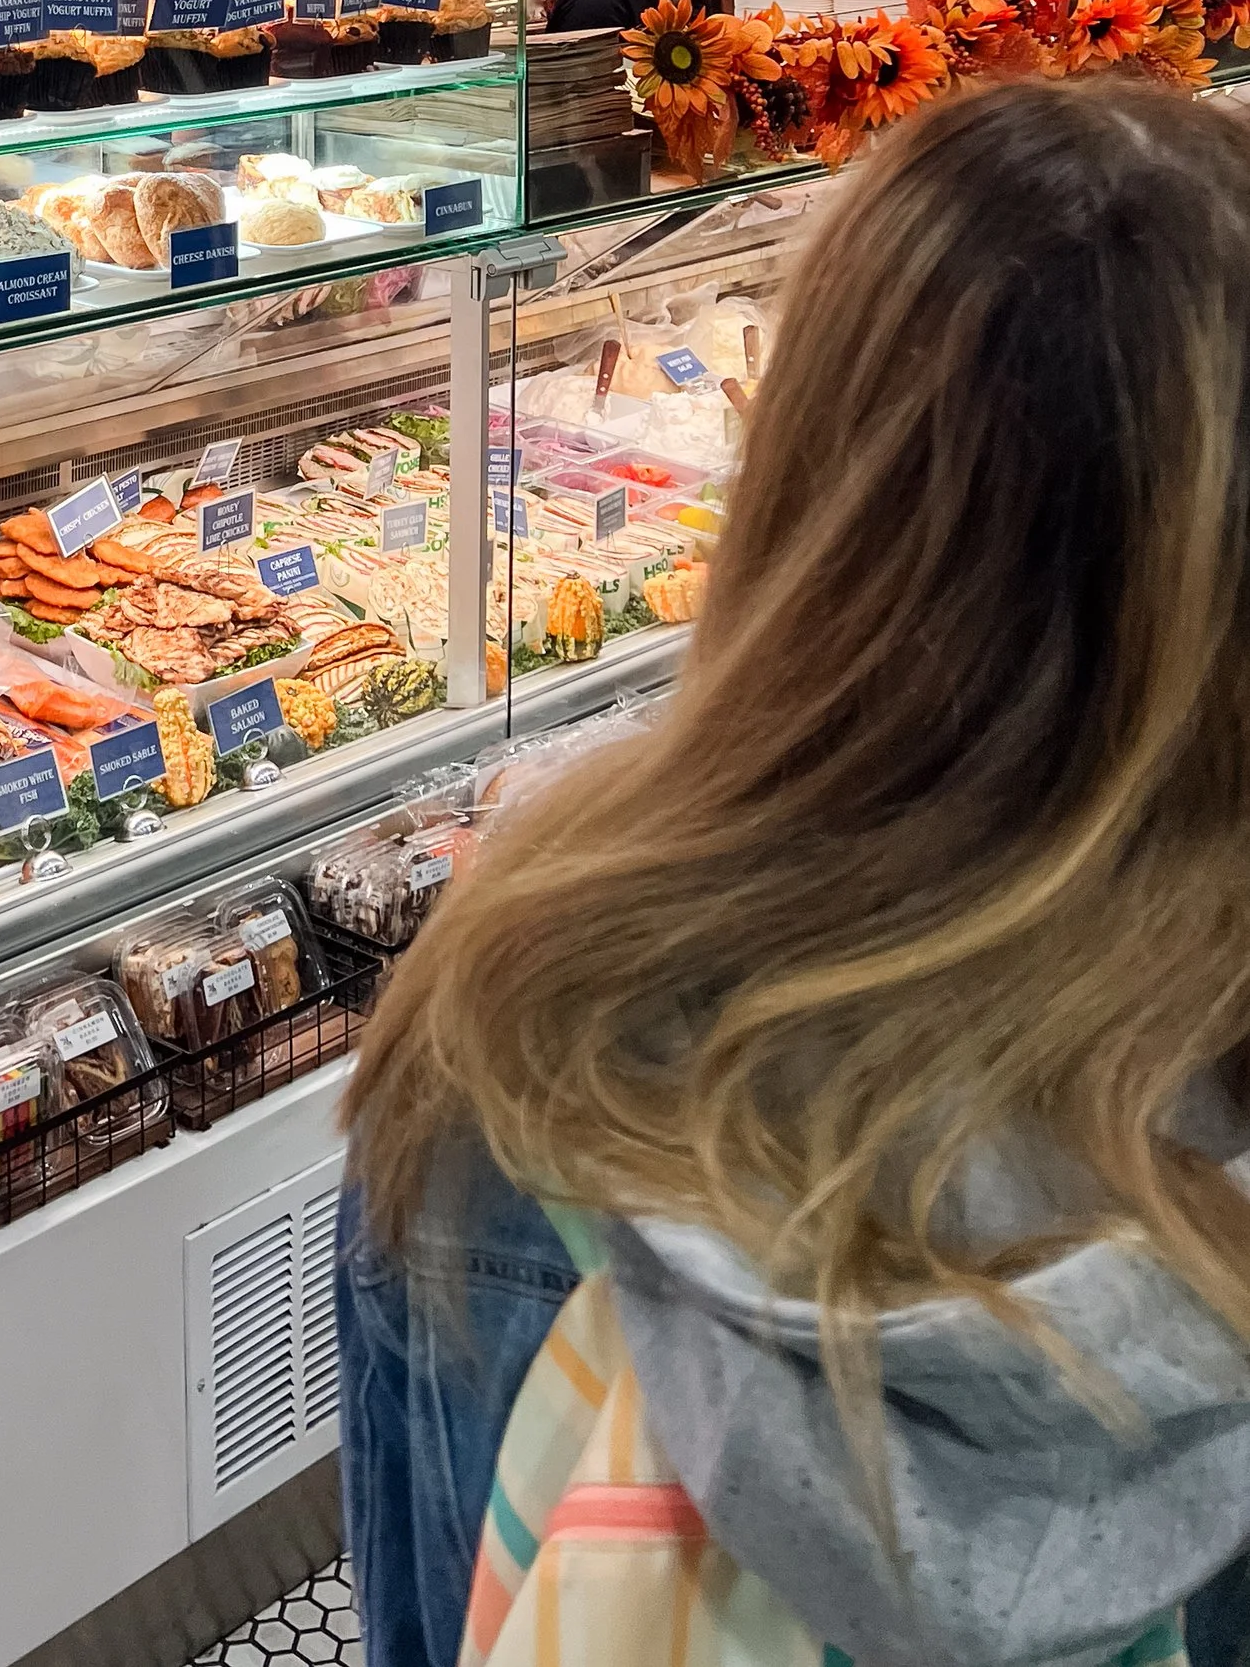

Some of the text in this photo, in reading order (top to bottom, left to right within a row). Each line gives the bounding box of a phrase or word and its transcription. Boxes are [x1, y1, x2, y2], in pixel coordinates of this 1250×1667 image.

[12, 6, 41, 20] YOGURT
[46, 4, 113, 17] YOGURT MUFFIN
[172, 13, 208, 24] MUFFIN
[227, 0, 283, 22] OGURT MUFFIN
[3, 22, 31, 35] MUFFIN
[173, 246, 235, 265] CHEESE DANISH
[36, 269, 68, 285] CREAM
[7, 286, 59, 304] CROISSANT
[217, 500, 240, 517] HONEY
[59, 498, 110, 537] CRISPY CHICKEN
[212, 513, 244, 530] CHIPOTLE
[270, 553, 303, 571] CAPRESE
[276, 565, 302, 582] PANINI
[230, 698, 260, 720] BAKED
[230, 710, 266, 735] SALMON
[99, 744, 158, 775] SMOKED SABLE
[28, 768, 55, 786] WHITE
[19, 789, 38, 806] FISH
